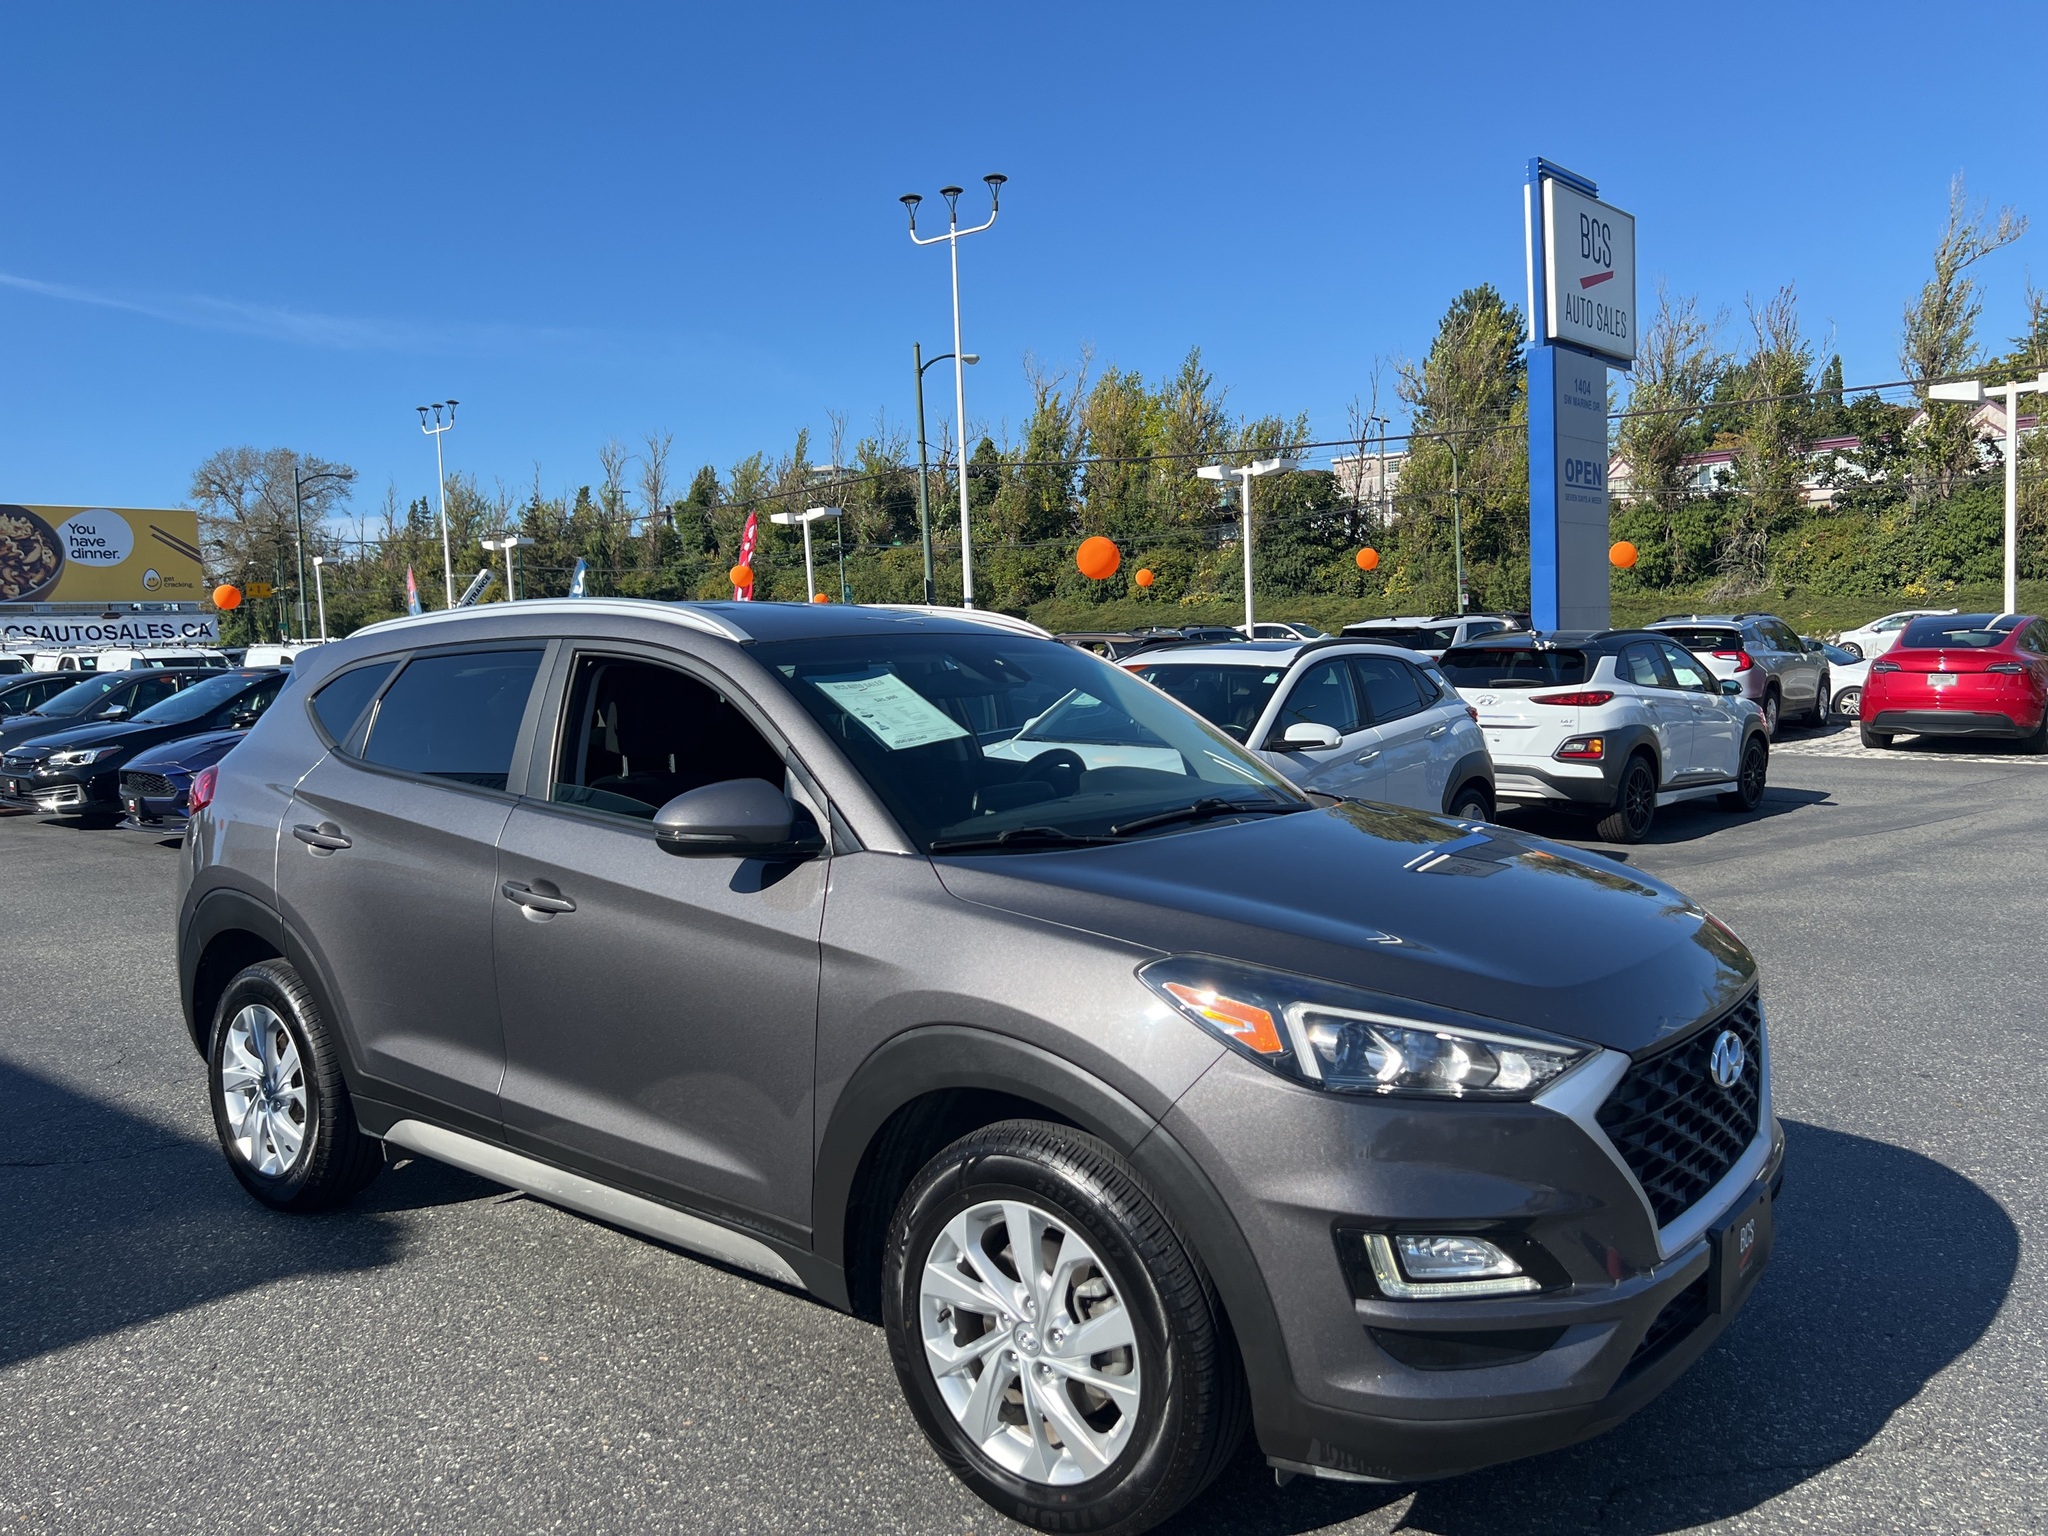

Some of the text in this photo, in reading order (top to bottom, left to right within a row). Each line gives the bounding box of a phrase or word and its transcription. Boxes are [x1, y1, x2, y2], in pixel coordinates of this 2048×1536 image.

[1580, 212, 1611, 268] BCS
[1565, 293, 1627, 339] AUTO SALES
[1574, 378, 1591, 395] 1404
[1563, 394, 1572, 405] SW
[1572, 396, 1592, 410] MARINE
[1565, 458, 1601, 486] OPEN
[68, 523, 96, 535] You
[69, 536, 106, 547] have
[71, 548, 120, 560] dinner.
[464, 574, 491, 607] NTRANCE
[1740, 1218, 1754, 1253] BCS
